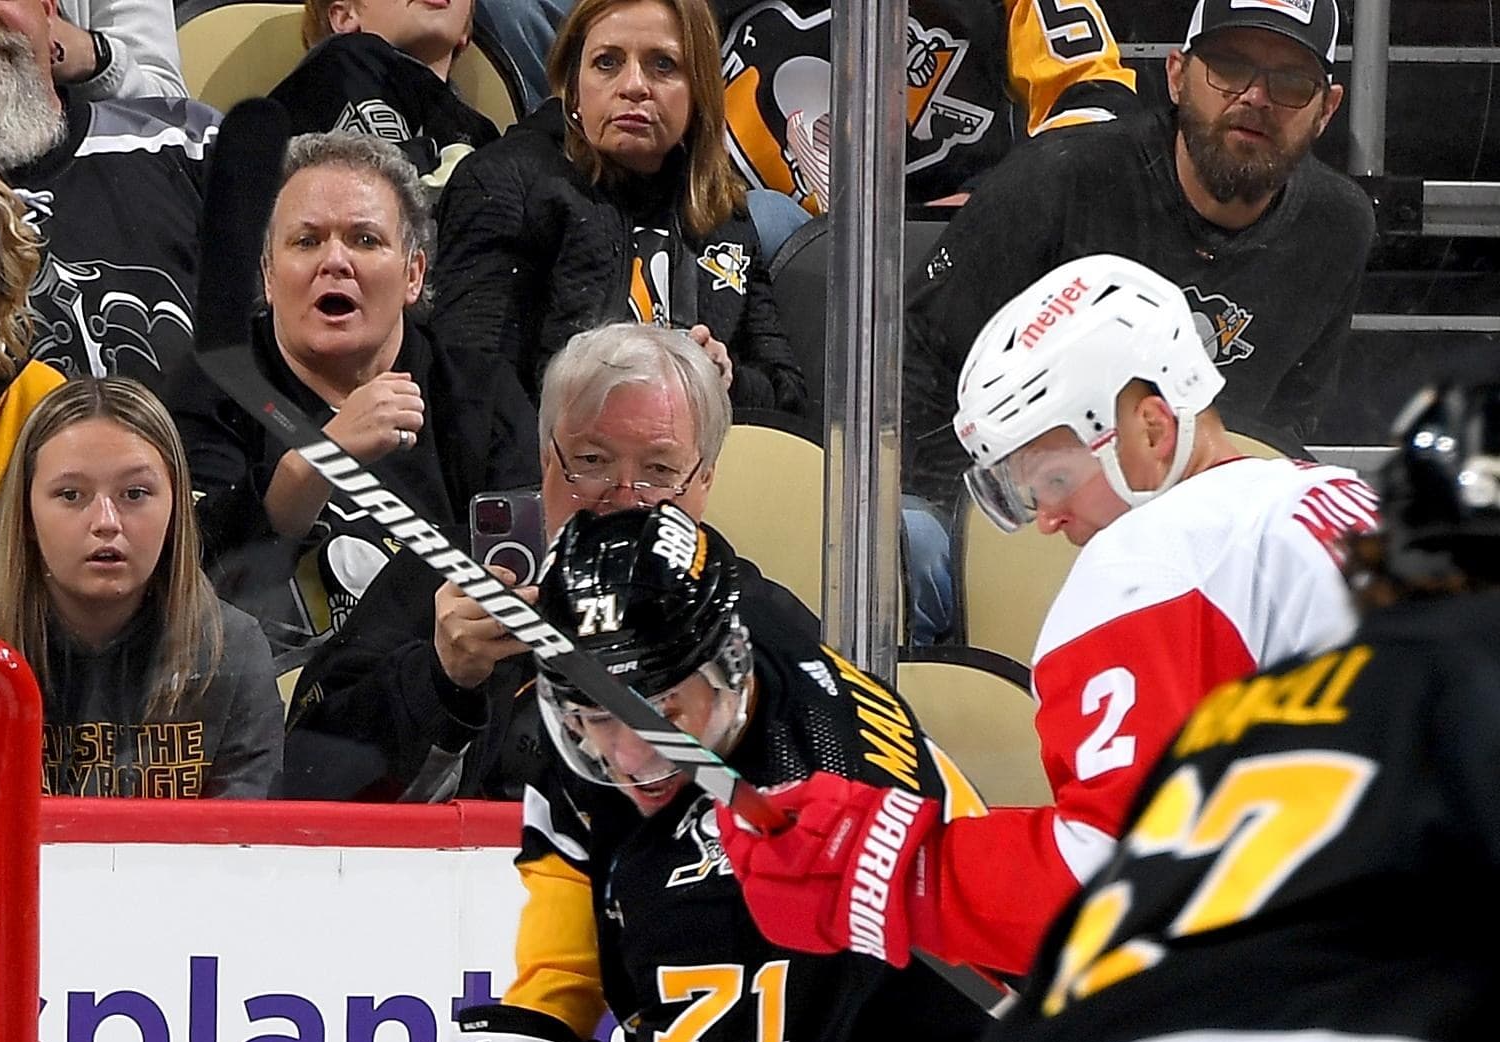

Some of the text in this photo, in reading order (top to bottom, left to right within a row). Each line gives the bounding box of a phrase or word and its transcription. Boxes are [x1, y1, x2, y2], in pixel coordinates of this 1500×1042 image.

[1017, 276, 1091, 350] meijer
[299, 440, 574, 660] WARRIOR
[576, 593, 620, 637] 71
[1076, 667, 1136, 781] 2
[849, 787, 924, 961] WARRIOR
